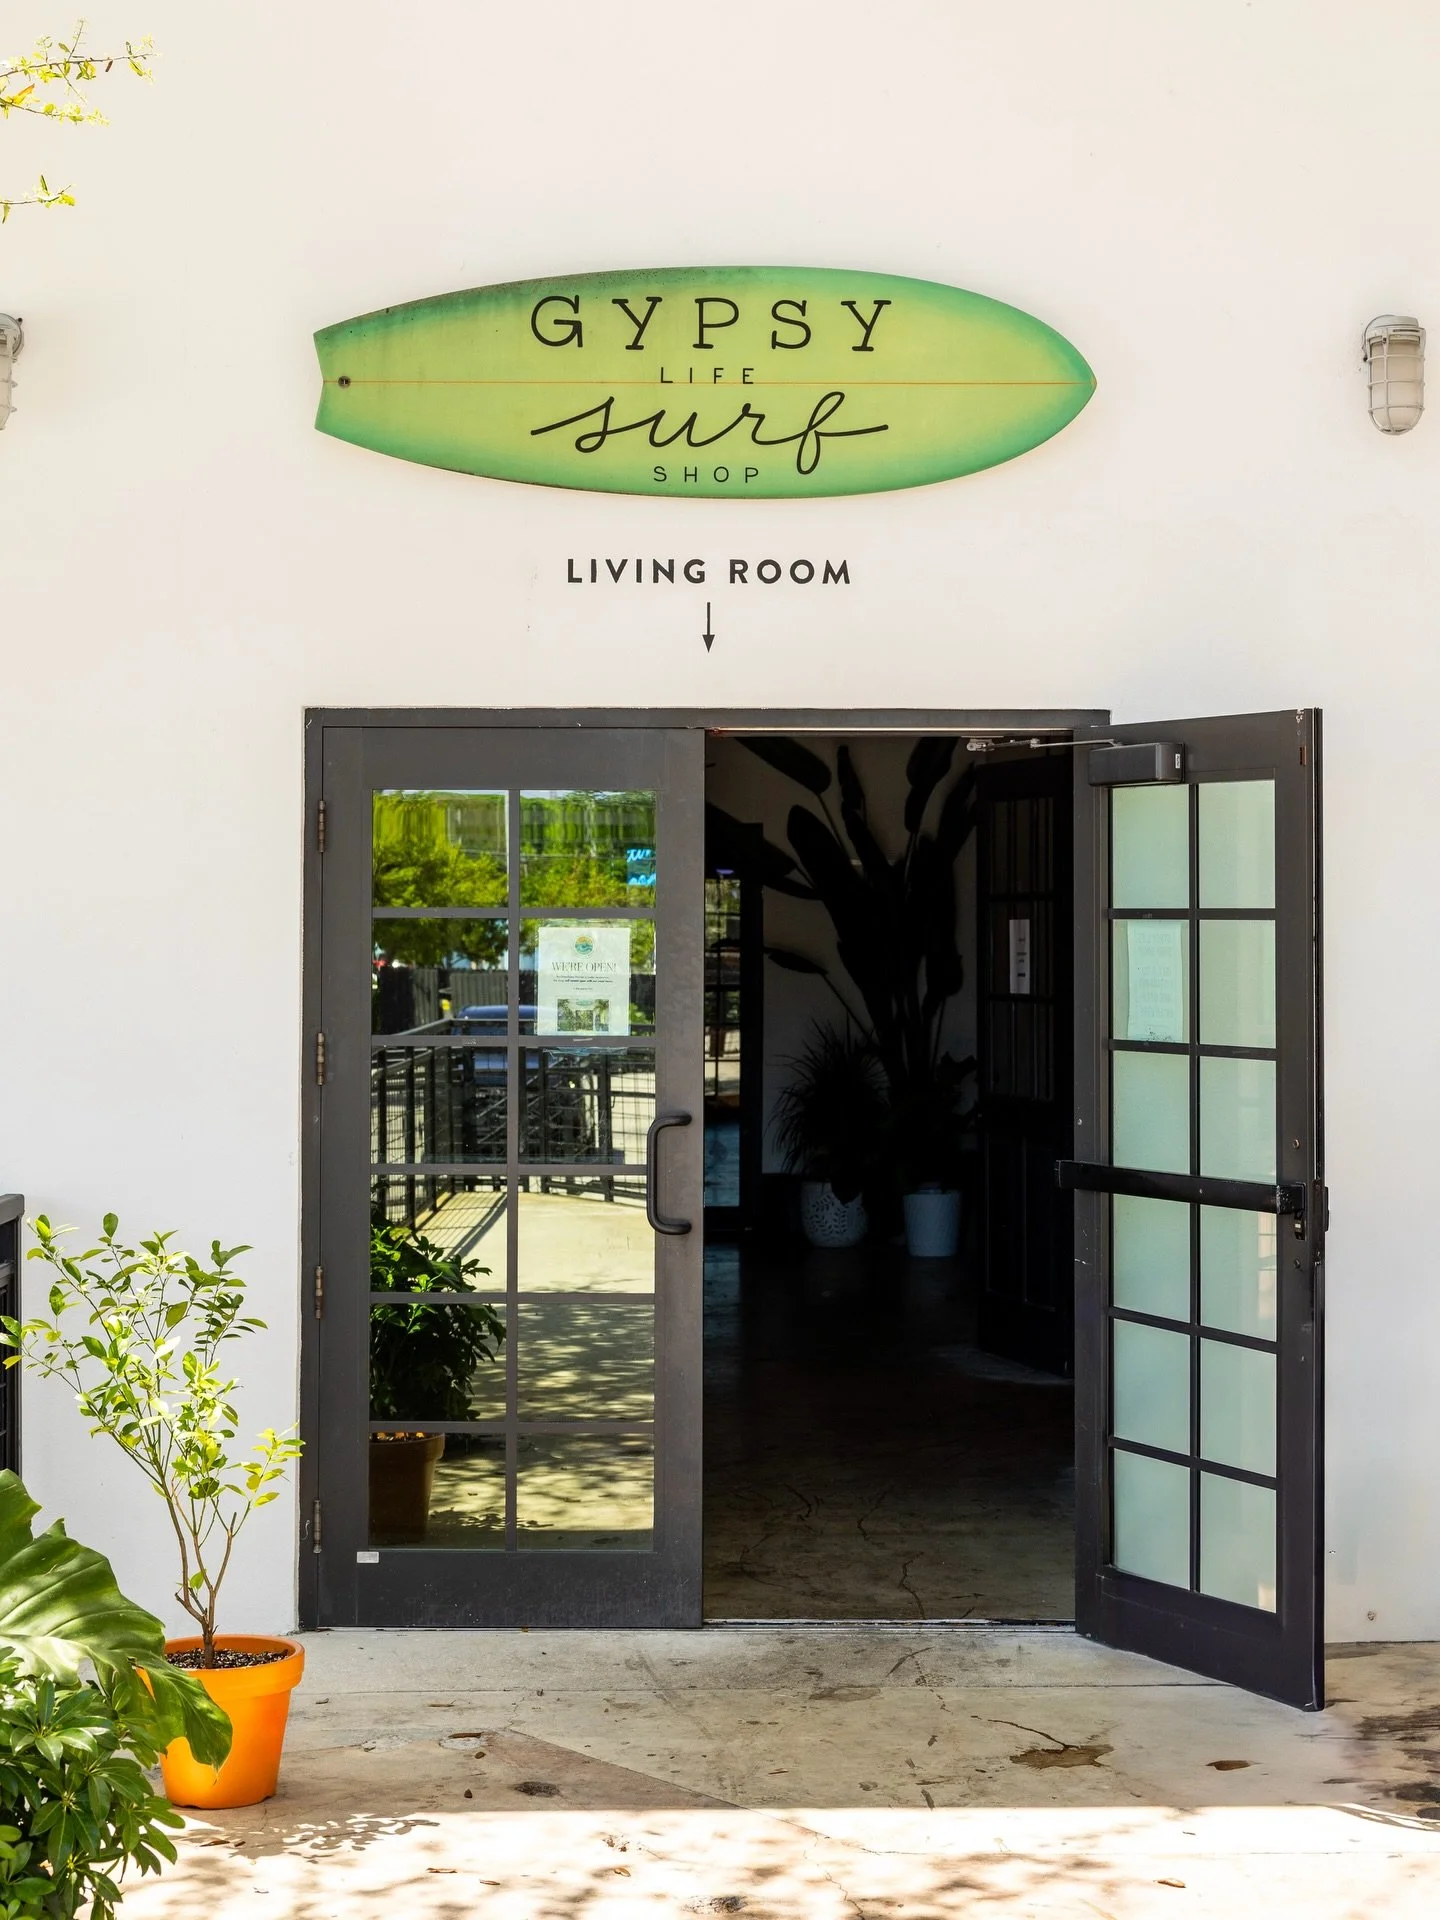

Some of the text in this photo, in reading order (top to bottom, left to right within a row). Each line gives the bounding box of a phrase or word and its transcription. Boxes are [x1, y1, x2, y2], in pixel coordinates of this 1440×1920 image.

[530, 294, 892, 352] GYPSY
[660, 366, 755, 385] LIFE
[530, 391, 889, 475] surf
[653, 465, 760, 484] SHOP
[567, 558, 851, 585] LIVING ROOM
[551, 961, 617, 973] WE'RE OPEN!
